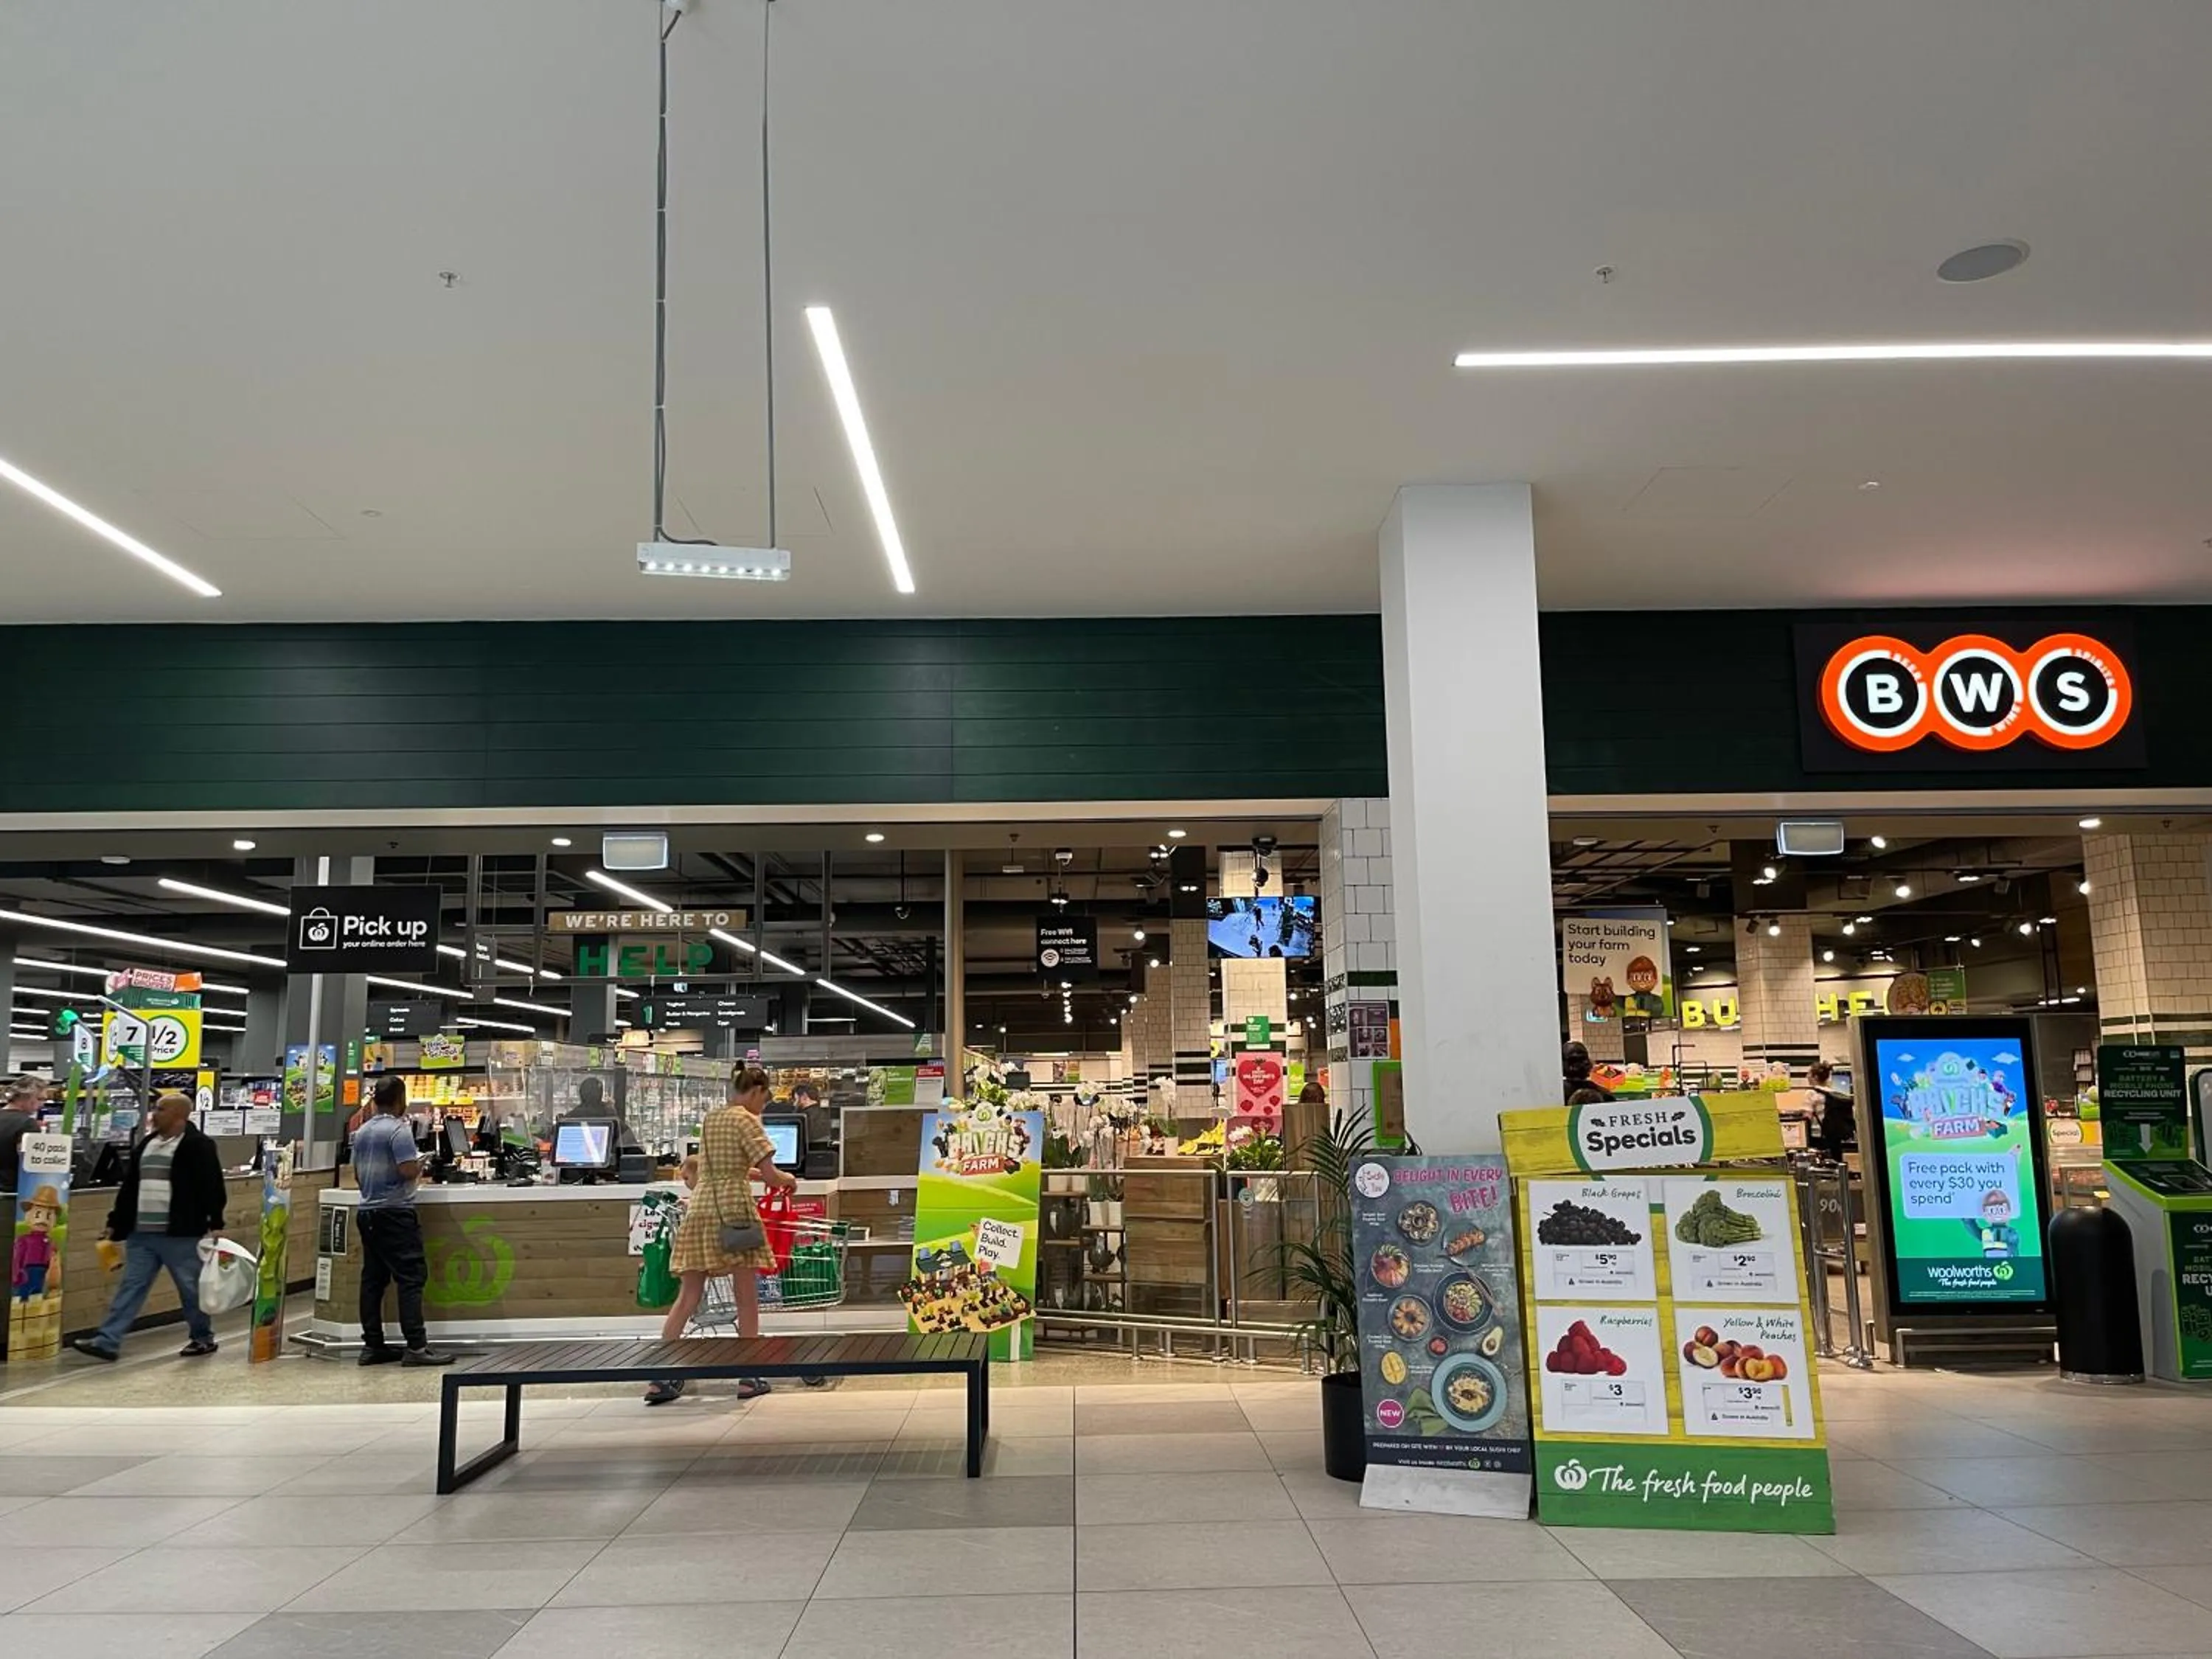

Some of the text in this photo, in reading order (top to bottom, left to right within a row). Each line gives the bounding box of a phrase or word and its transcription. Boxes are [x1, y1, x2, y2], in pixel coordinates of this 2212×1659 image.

[343, 915, 428, 940] Pick up
[566, 912, 729, 928] WE'RE HERE TO
[1568, 923, 1655, 940] Start building
[342, 941, 361, 949] your
[1568, 939, 1630, 952] your farm
[579, 943, 714, 977] HELP
[1568, 952, 1607, 967] today
[135, 971, 173, 983] PRICES
[126, 1026, 139, 1042] 7
[2104, 1089, 2182, 1098] RECYCLING UNIT
[1608, 1111, 1668, 1127] FRESH
[1933, 1120, 1980, 1136] FARM
[32, 1142, 45, 1152] 40
[1586, 1124, 1697, 1156] Specials
[962, 1158, 1000, 1172] FARM
[1907, 1161, 2005, 1175] Free pack with
[1392, 1167, 1503, 1183] DELIGHT IN EVERY
[1909, 1176, 2003, 1192] every $30 you
[1449, 1185, 1498, 1214] BITE!
[1581, 1187, 1642, 1201] Black Grapes
[1927, 1265, 1992, 1279] woolworths
[1599, 1315, 1652, 1327] Raspberries
[1723, 1315, 1794, 1330] Yellow & White
[1760, 1330, 1796, 1342] Peaches
[1608, 1384, 1623, 1396] $3
[1380, 1409, 1401, 1417] NEW
[1589, 1464, 1814, 1506] The fresh food people
